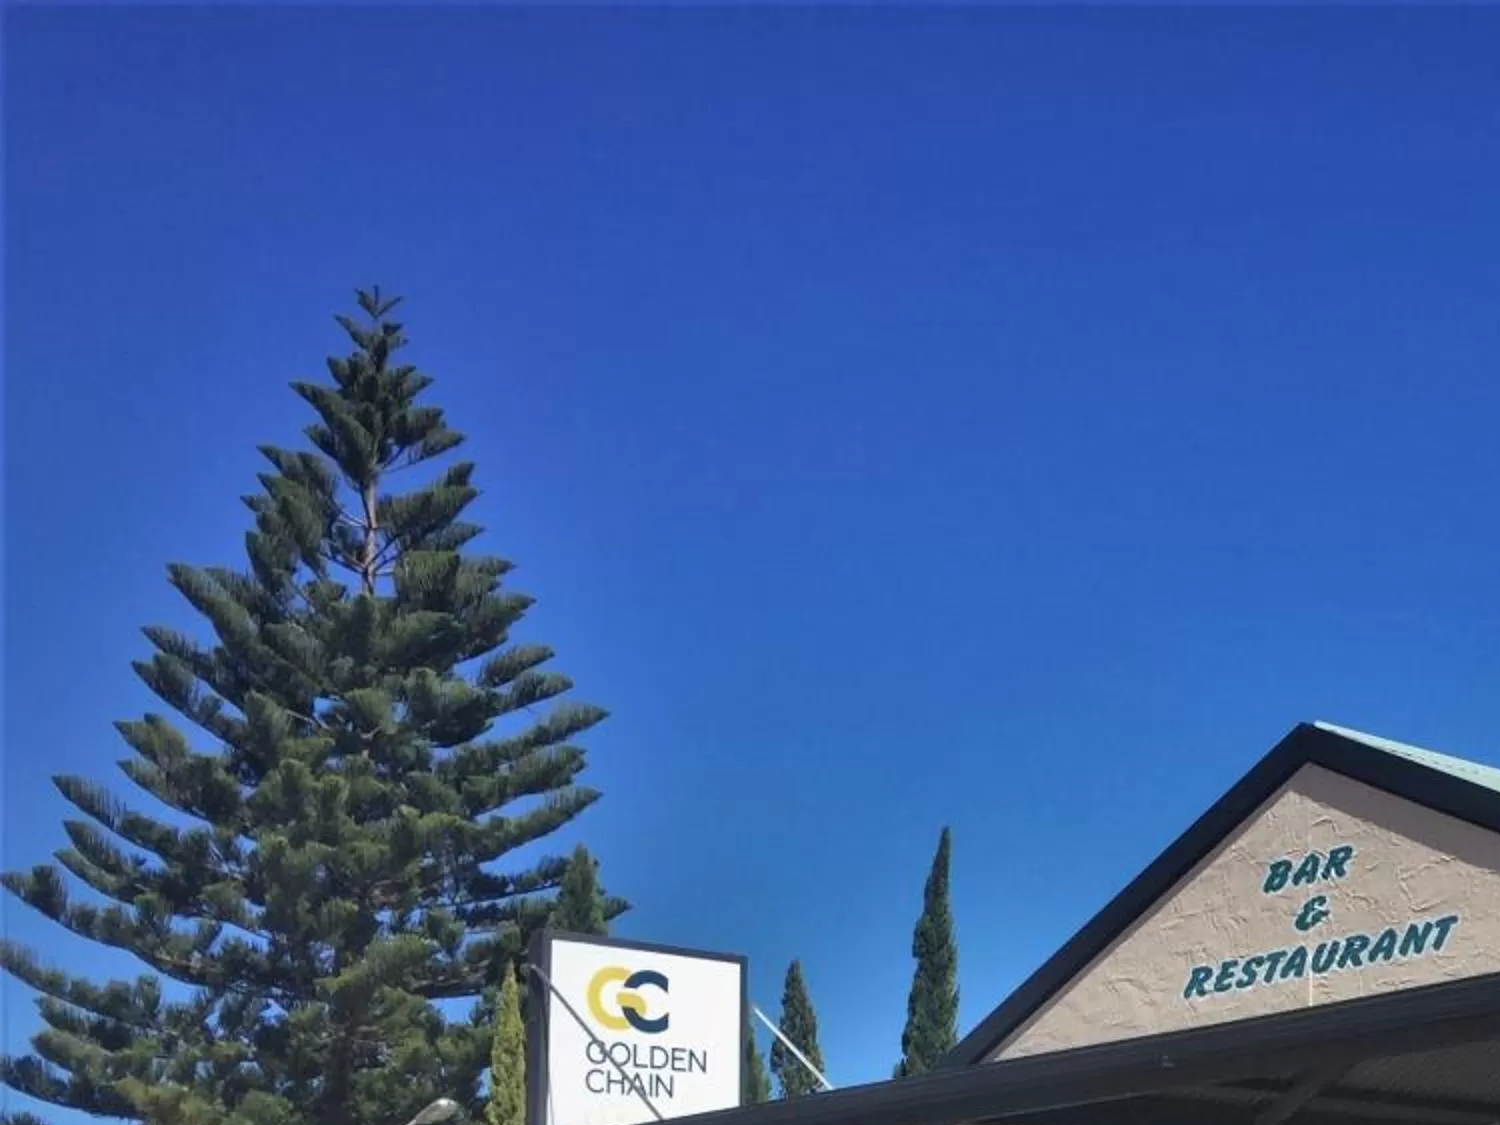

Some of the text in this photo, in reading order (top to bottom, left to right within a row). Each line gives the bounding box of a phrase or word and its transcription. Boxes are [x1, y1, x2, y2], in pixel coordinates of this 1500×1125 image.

[1262, 845, 1354, 895] BAR
[1295, 895, 1331, 931] &
[1183, 915, 1459, 999] RESTAURANT
[586, 1041, 707, 1073] GOLDEN
[586, 1069, 674, 1098] CHAIN
